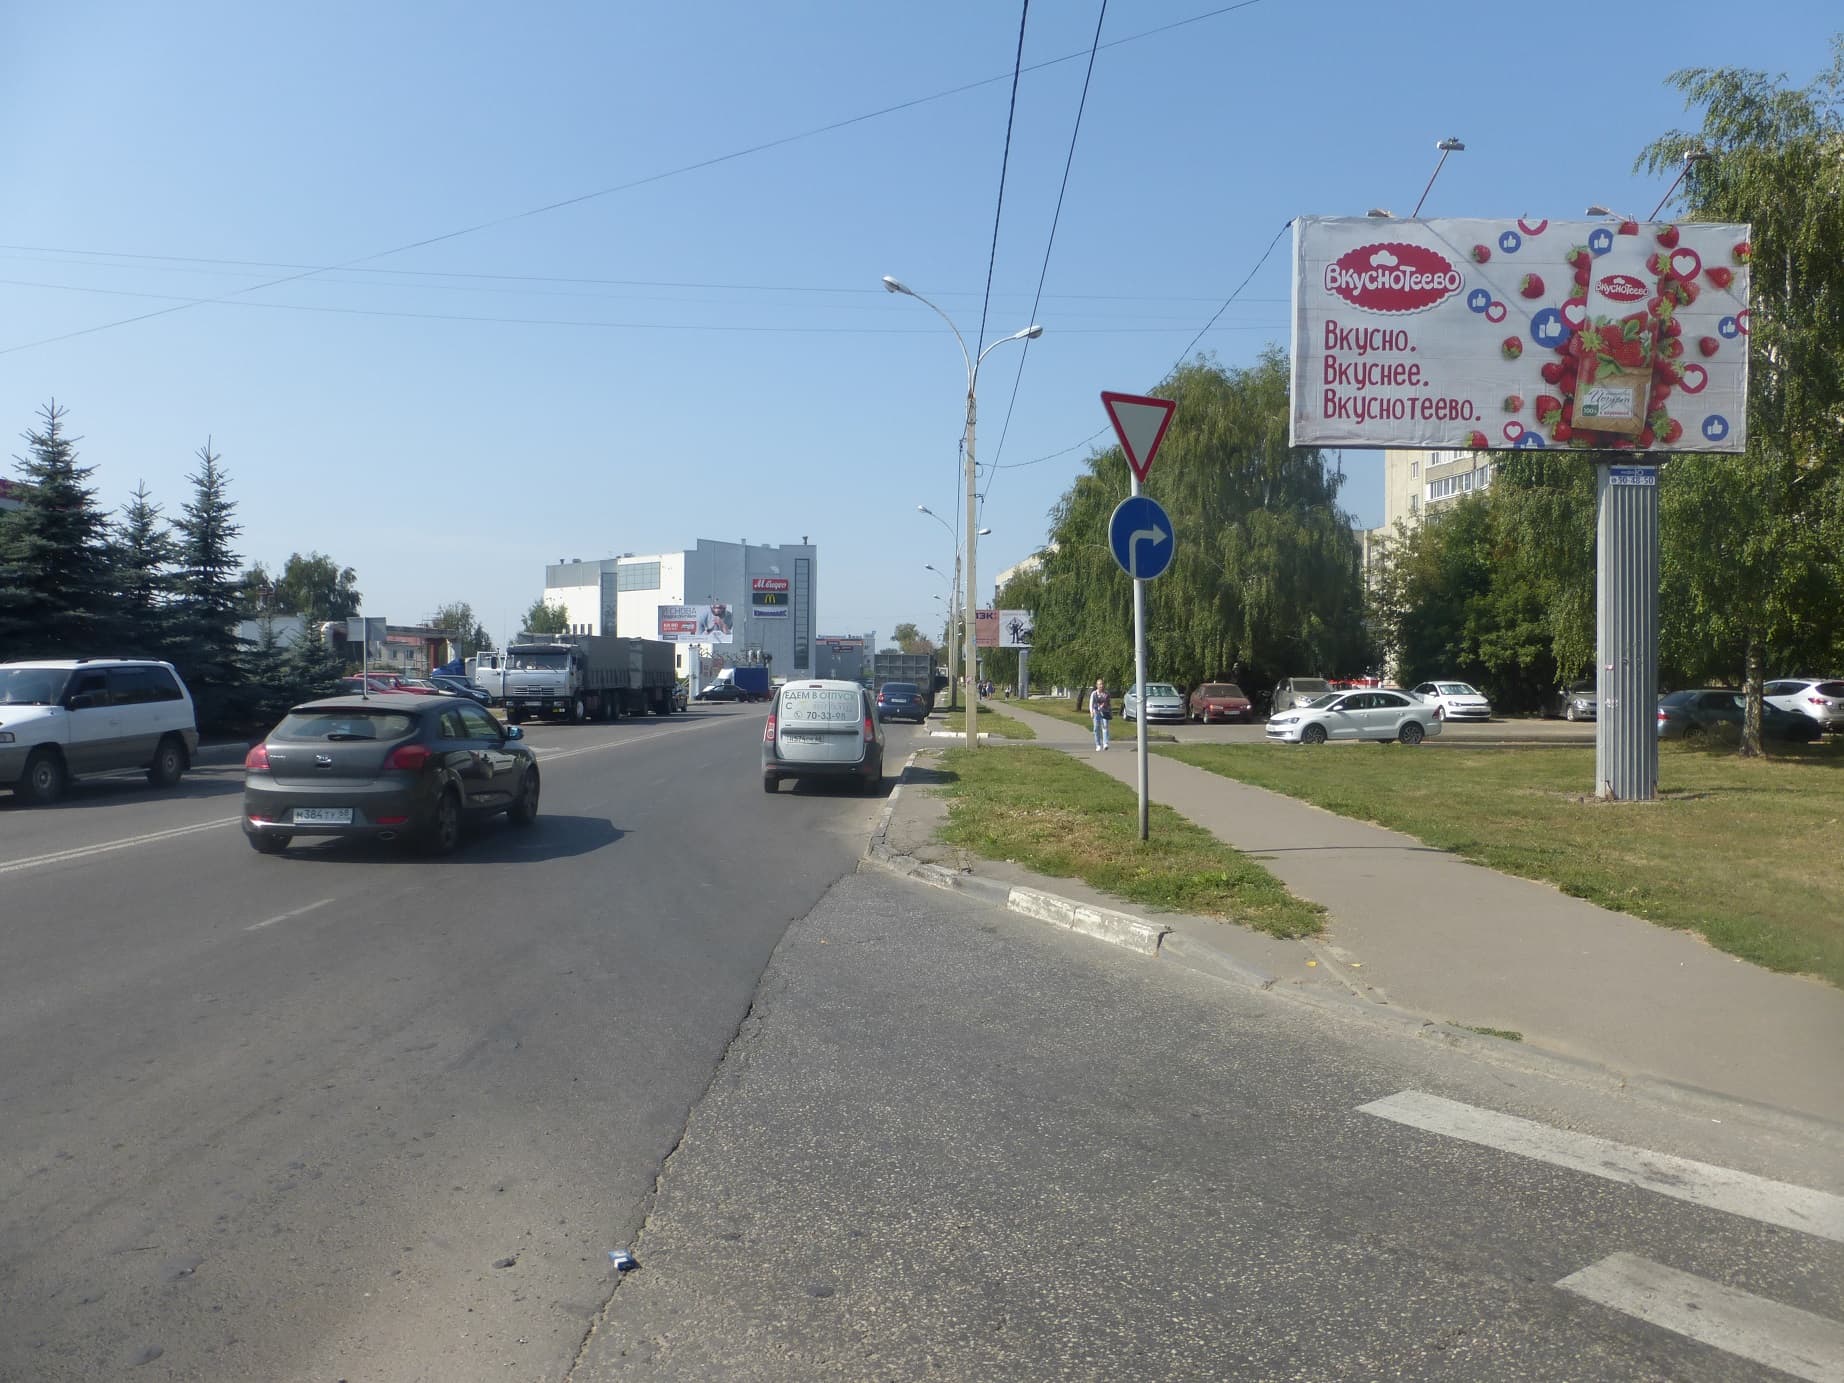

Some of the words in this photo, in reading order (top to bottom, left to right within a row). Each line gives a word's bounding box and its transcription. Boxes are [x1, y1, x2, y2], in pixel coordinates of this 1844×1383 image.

[1324, 319, 1417, 356] Вкусно.
[1323, 354, 1430, 391] Вкуснее.
[1323, 388, 1482, 425] Вкуснотеево.
[785, 691, 810, 700] ЕДЕМ
